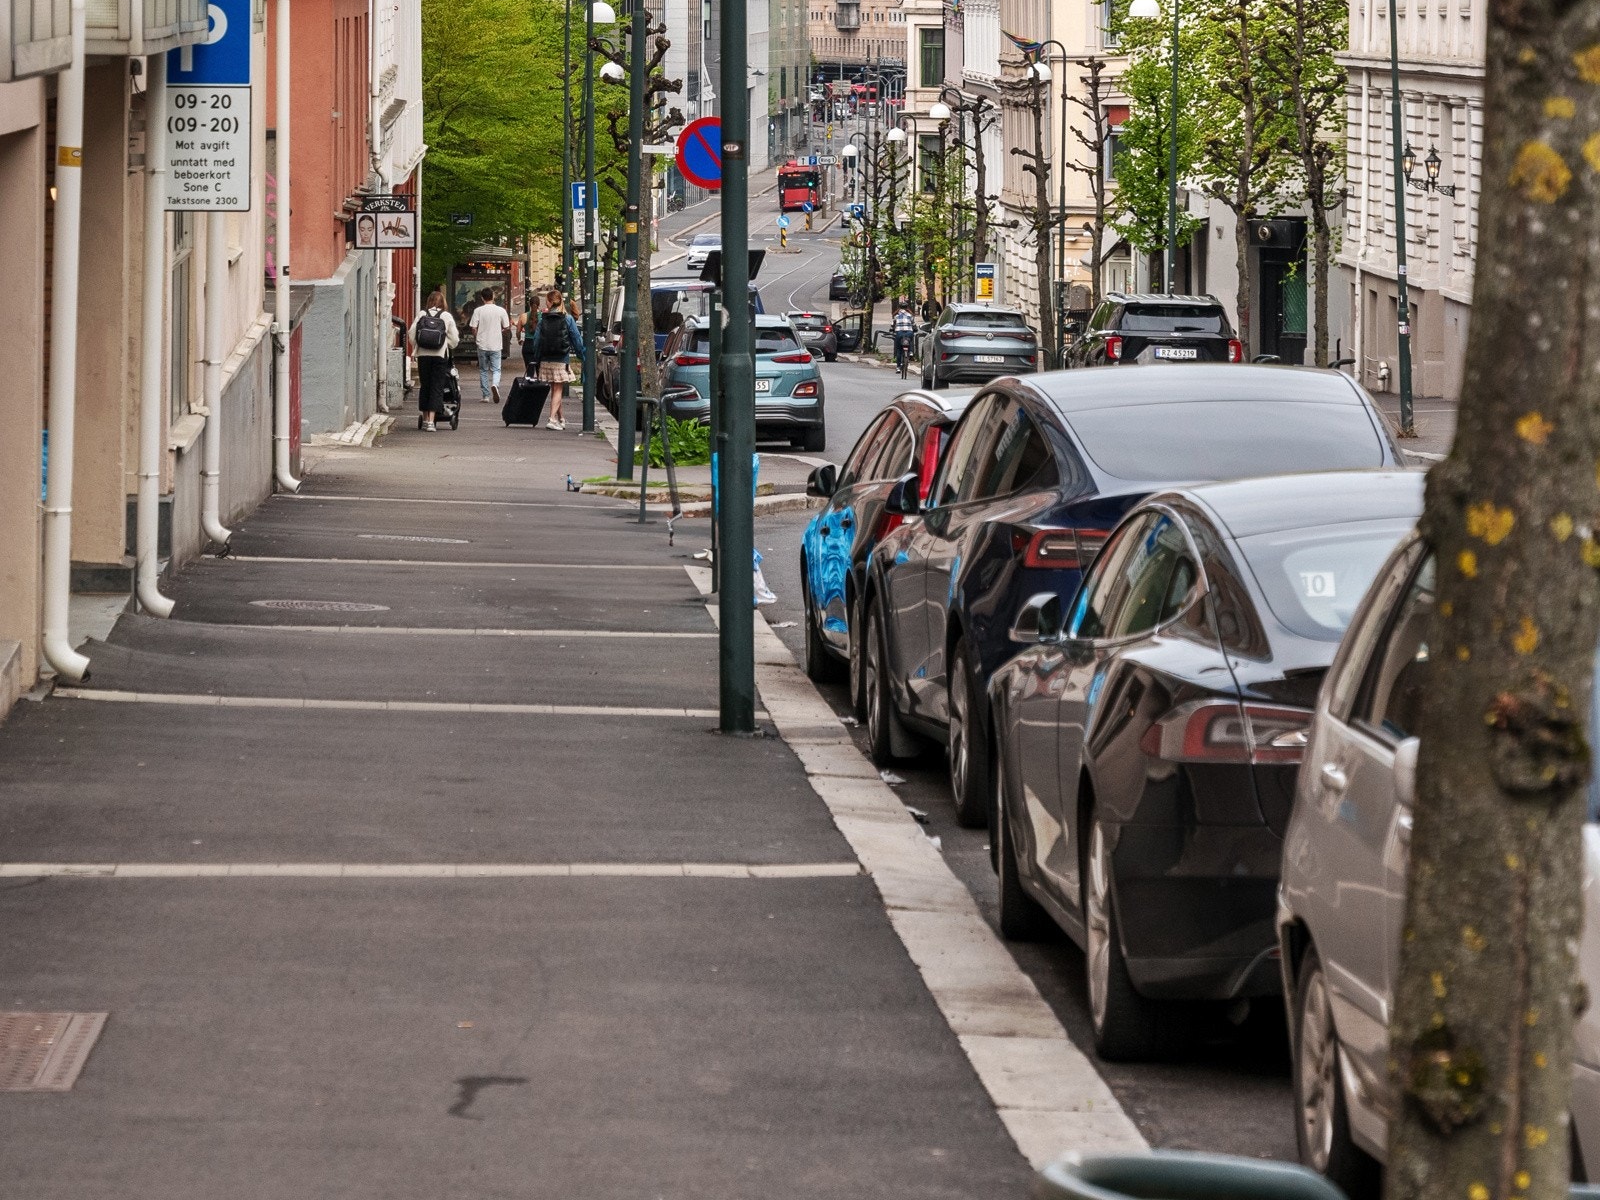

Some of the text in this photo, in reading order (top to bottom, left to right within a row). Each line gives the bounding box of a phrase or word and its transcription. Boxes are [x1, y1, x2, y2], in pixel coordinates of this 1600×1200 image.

[175, 140, 230, 153] Mot avgift
[170, 157, 235, 167] unntatt med
[174, 169, 231, 180] beboerkort
[183, 183, 221, 192] Sone C
[167, 196, 238, 205] Takstsone 2300
[364, 199, 406, 211] VERKSTED
